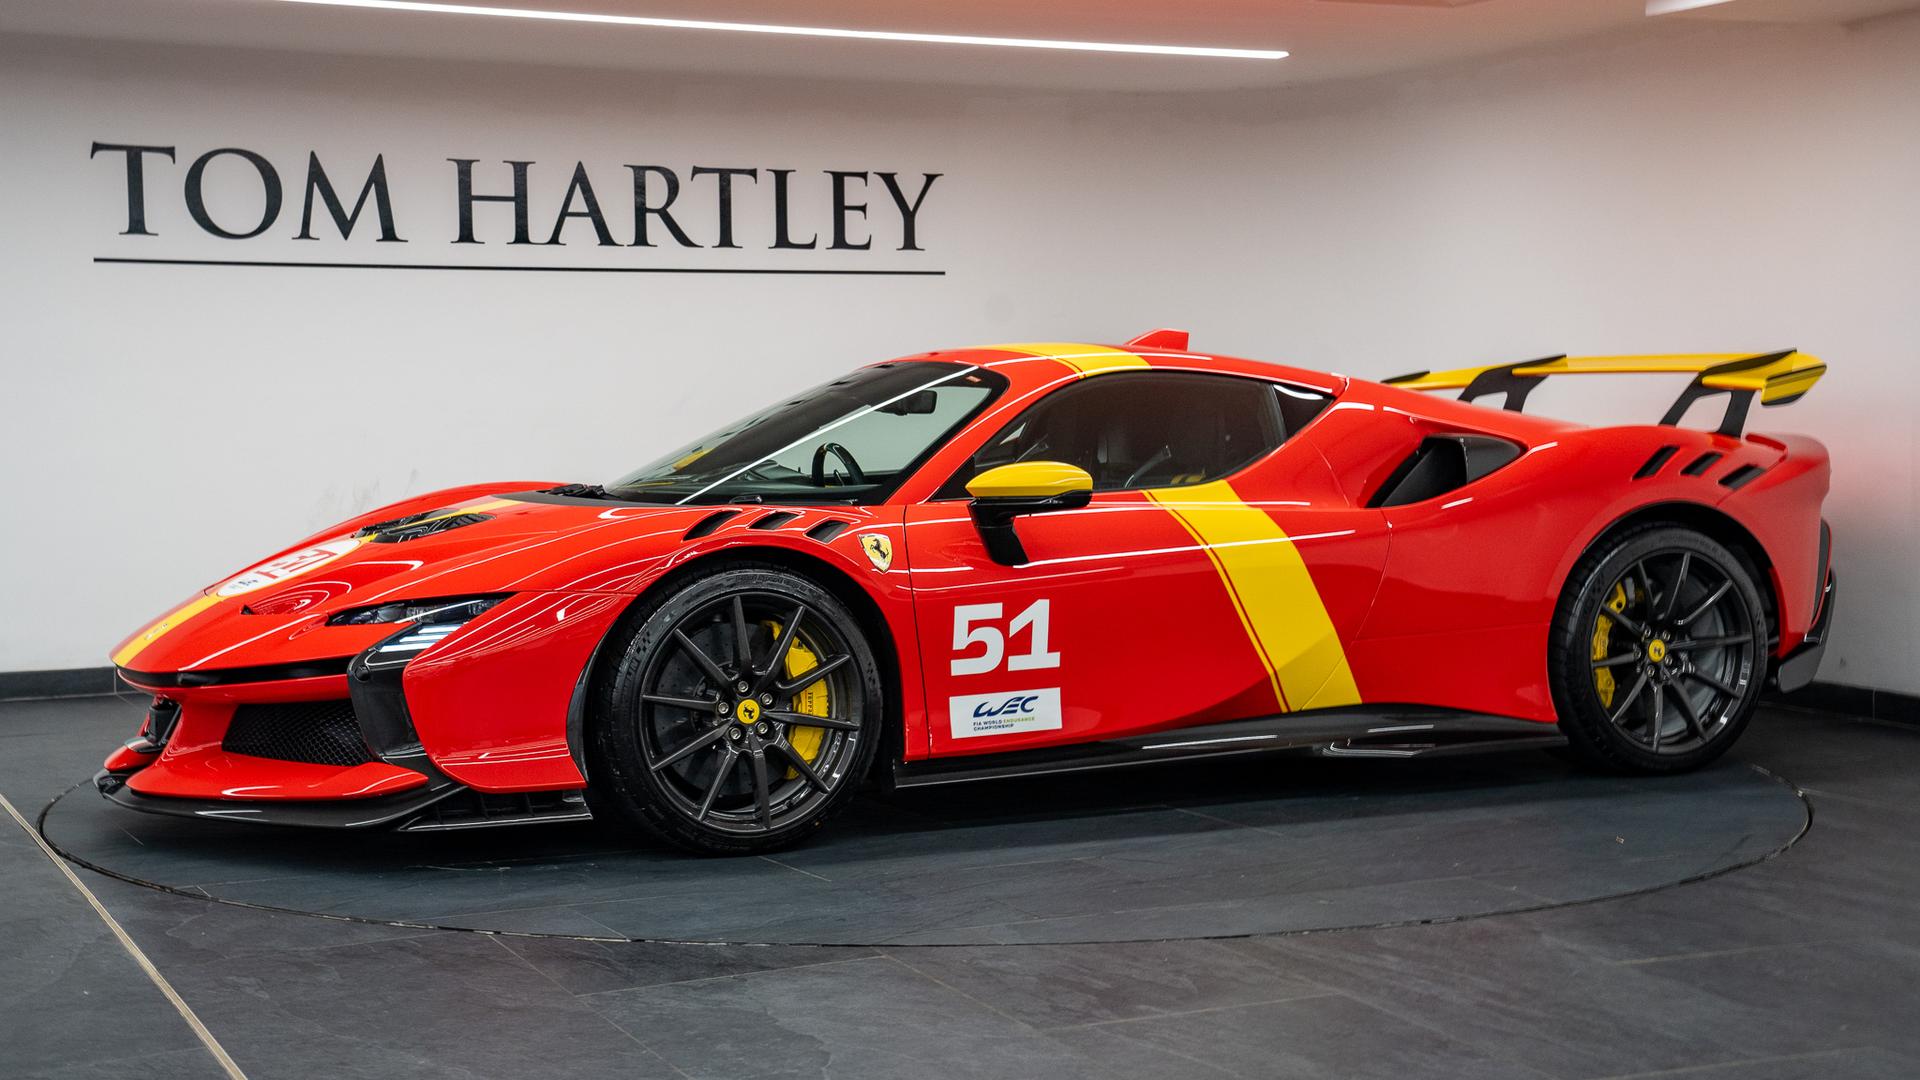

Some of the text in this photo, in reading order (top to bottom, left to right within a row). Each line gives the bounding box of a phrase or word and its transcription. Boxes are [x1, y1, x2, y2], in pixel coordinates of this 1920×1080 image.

[91, 141, 944, 252] TOM HARTLEY
[951, 599, 1061, 676] 51
[973, 696, 1039, 718] WEC
[973, 723, 1014, 732] CHAMPIONSHIP
[1003, 716, 1035, 724] ENDURANCE
